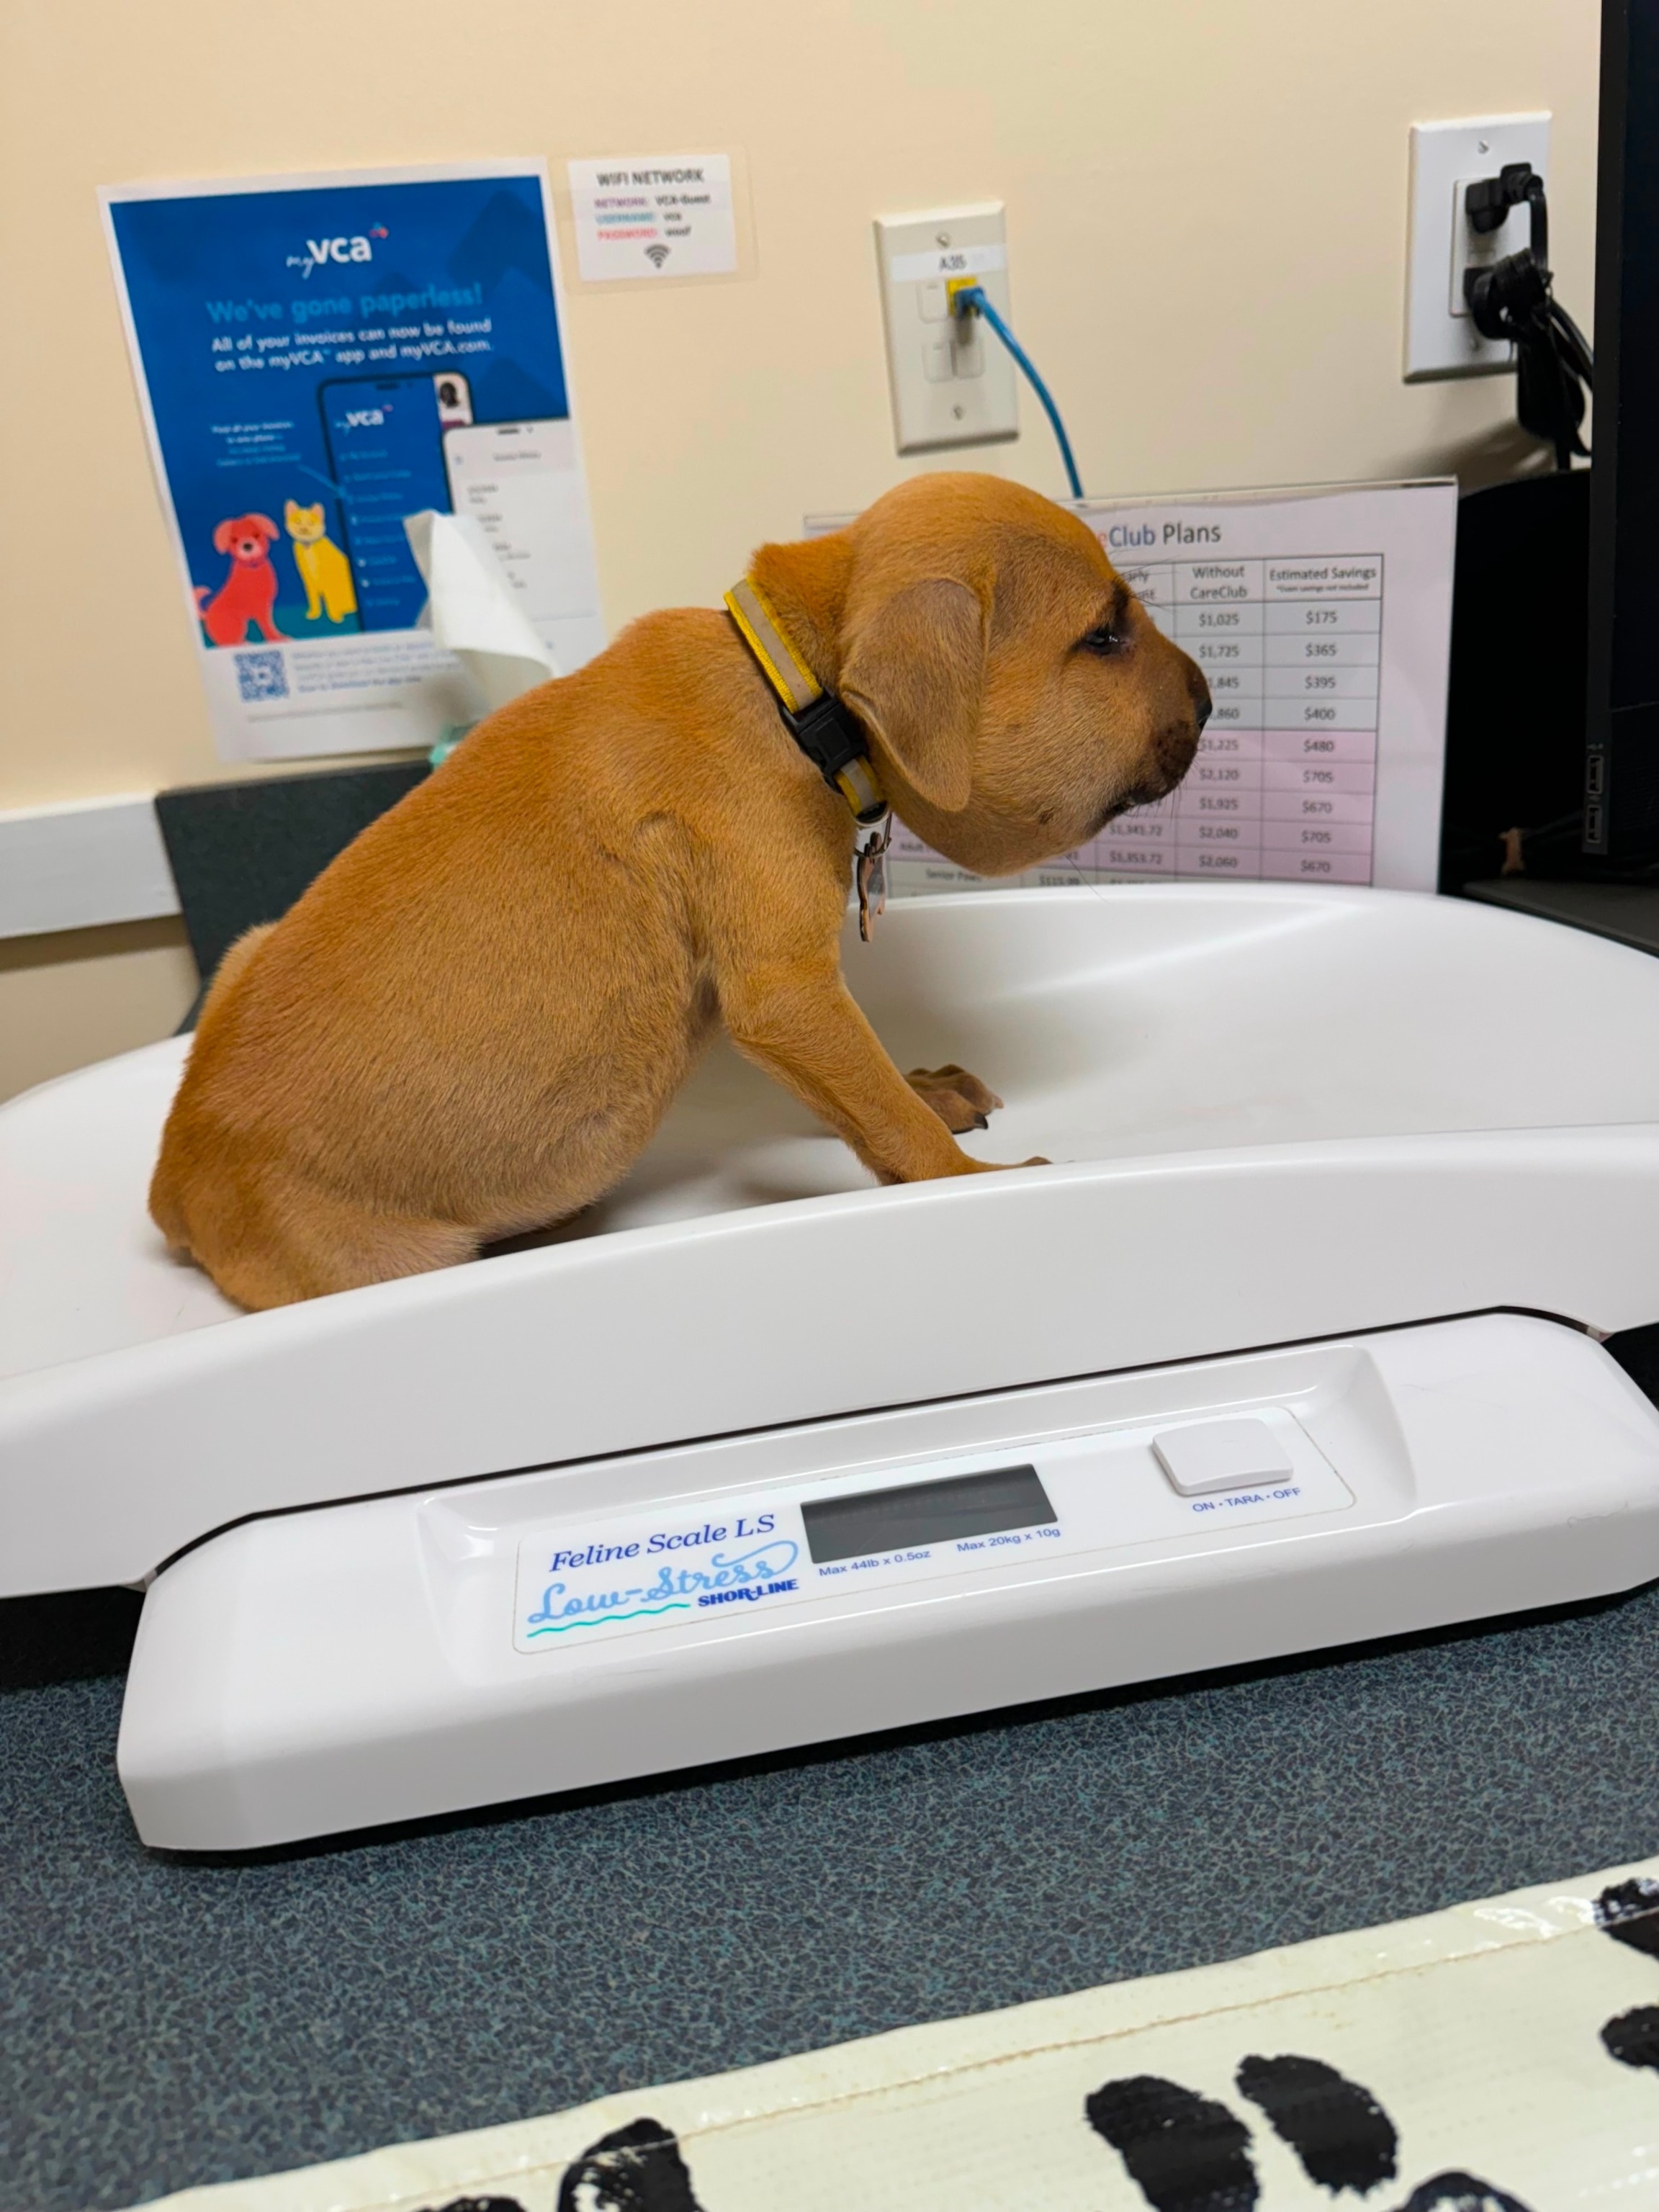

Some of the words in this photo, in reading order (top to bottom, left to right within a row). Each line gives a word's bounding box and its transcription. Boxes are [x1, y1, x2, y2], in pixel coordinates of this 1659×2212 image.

[632, 169, 703, 184] NETWORK
[205, 298, 283, 323] We've
[291, 297, 352, 324] gone
[361, 281, 482, 318] paperless!
[212, 336, 233, 352] All
[236, 333, 253, 351] of
[256, 336, 290, 353] your
[294, 330, 355, 346] invoices
[358, 328, 385, 342] can
[387, 326, 421, 339] now
[423, 320, 444, 337] be
[447, 315, 492, 335] found
[215, 359, 235, 372] on
[238, 355, 265, 370] the
[336, 349, 365, 366] app
[368, 343, 397, 360] and
[1162, 521, 1221, 545] Plans
[1192, 566, 1244, 579] Without
[1269, 567, 1328, 581] Estimated
[1331, 566, 1377, 580] Savings
[1190, 585, 1248, 600] CareClub
[1198, 613, 1239, 628] $1,025
[1306, 610, 1338, 626] $175
[1198, 644, 1239, 659] $1,725
[1305, 643, 1337, 658] $365
[1207, 676, 1239, 691] 1,845
[1305, 675, 1336, 690] $395
[1304, 707, 1336, 721] $400
[1199, 738, 1238, 752] $1,225
[1303, 738, 1334, 753] $480
[1200, 768, 1239, 781] $2,120
[1303, 770, 1334, 784] $705
[1199, 797, 1238, 811] $1,925
[1302, 800, 1332, 814] $670
[1199, 826, 1238, 840] $2,040
[1301, 830, 1331, 844] $705
[1300, 859, 1331, 873] $670
[1192, 1501, 1215, 1512] ON
[1224, 1494, 1265, 1507] TARA
[1273, 1487, 1301, 1499] OFF
[549, 1542, 640, 1573] Feline
[647, 1524, 727, 1555] Scale
[734, 1514, 775, 1539] LS
[956, 1541, 986, 1552] Max
[989, 1534, 1021, 1548] 20kg
[1024, 1532, 1033, 1541] x
[1035, 1527, 1061, 1540] 10g
[819, 1565, 847, 1577] Max
[851, 1558, 879, 1571] 44lb
[884, 1557, 891, 1566] x
[894, 1550, 931, 1563] 0.5oz
[527, 1540, 799, 1624] Low-Stress
[698, 1578, 799, 1607] SHOR-LINE
